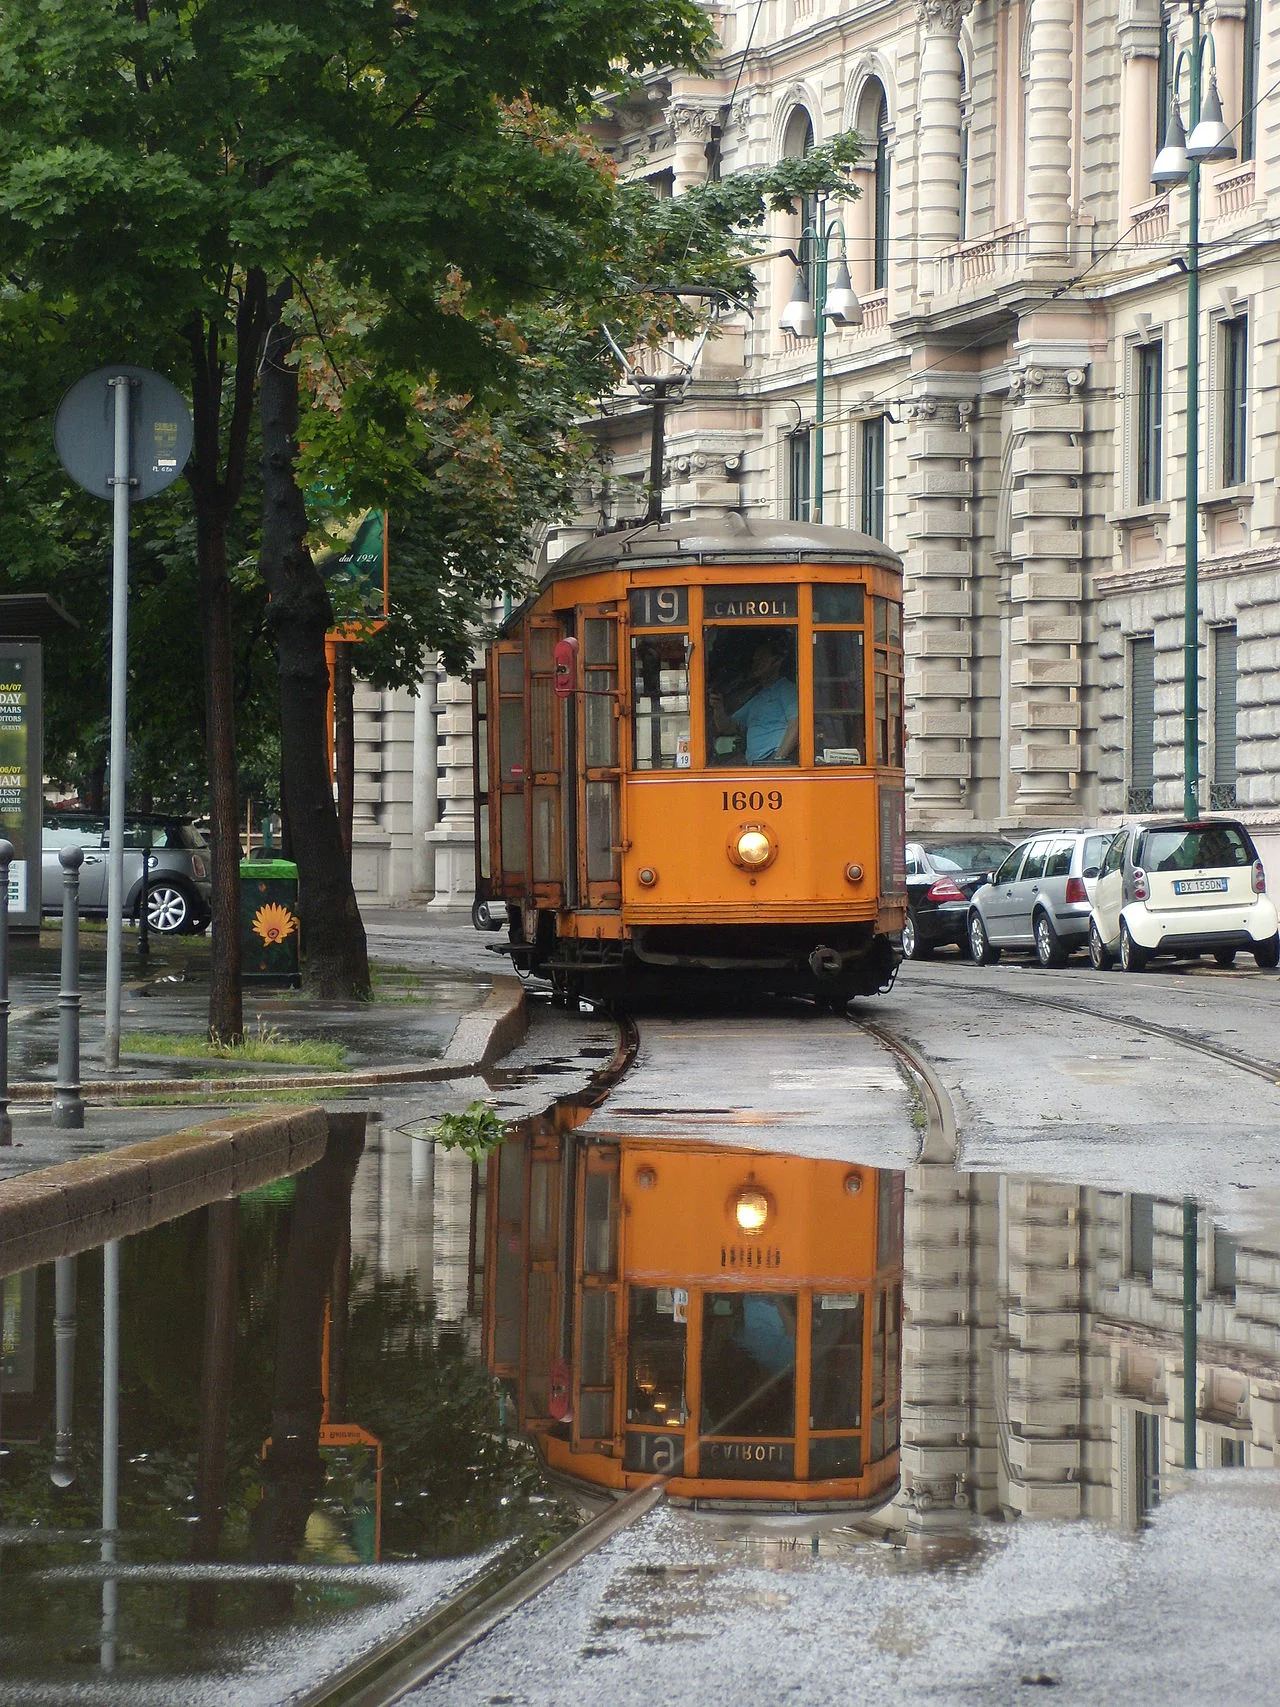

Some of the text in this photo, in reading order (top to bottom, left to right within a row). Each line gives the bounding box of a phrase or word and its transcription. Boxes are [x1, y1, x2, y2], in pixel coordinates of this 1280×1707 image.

[338, 553, 379, 563] dal 1921
[643, 588, 680, 624] 19
[714, 601, 787, 616] CAIROLI
[721, 790, 783, 811] 1609
[1180, 879, 1222, 892] BX 155DN
